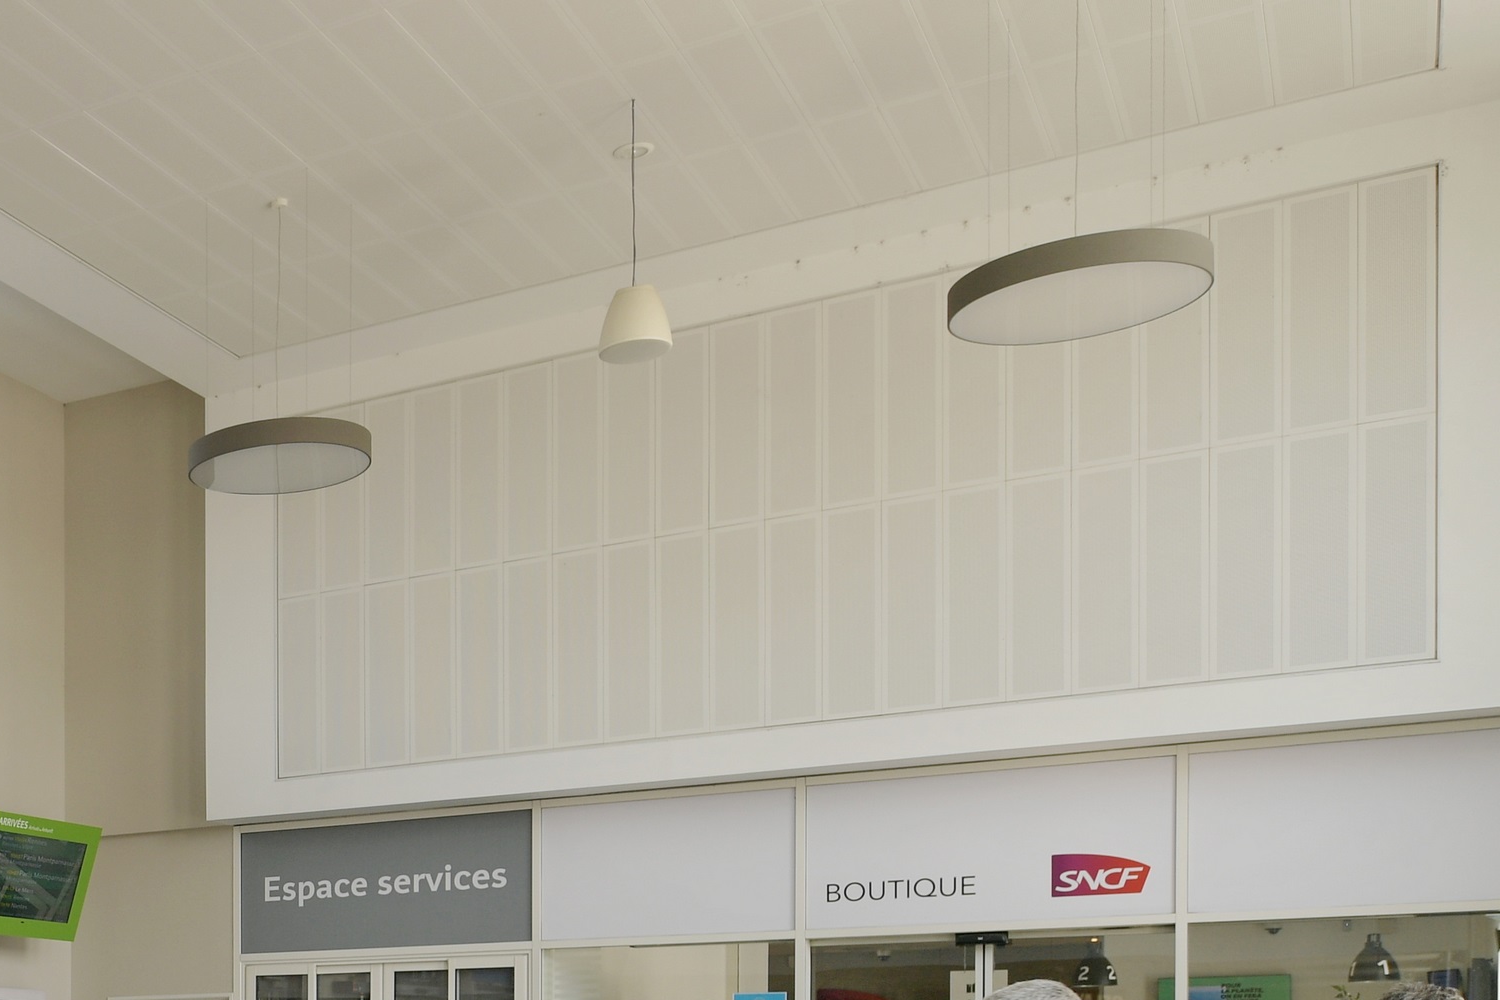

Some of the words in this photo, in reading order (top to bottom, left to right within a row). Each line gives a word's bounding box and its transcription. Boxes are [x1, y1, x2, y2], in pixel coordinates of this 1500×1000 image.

[264, 876, 368, 907] Espace
[378, 864, 508, 895] services
[826, 876, 976, 902] BOUTIQUE
[1055, 866, 1144, 893] SNCF
[1078, 966, 1090, 980] 2
[1106, 966, 1116, 980] 2
[1378, 960, 1390, 976] 1
